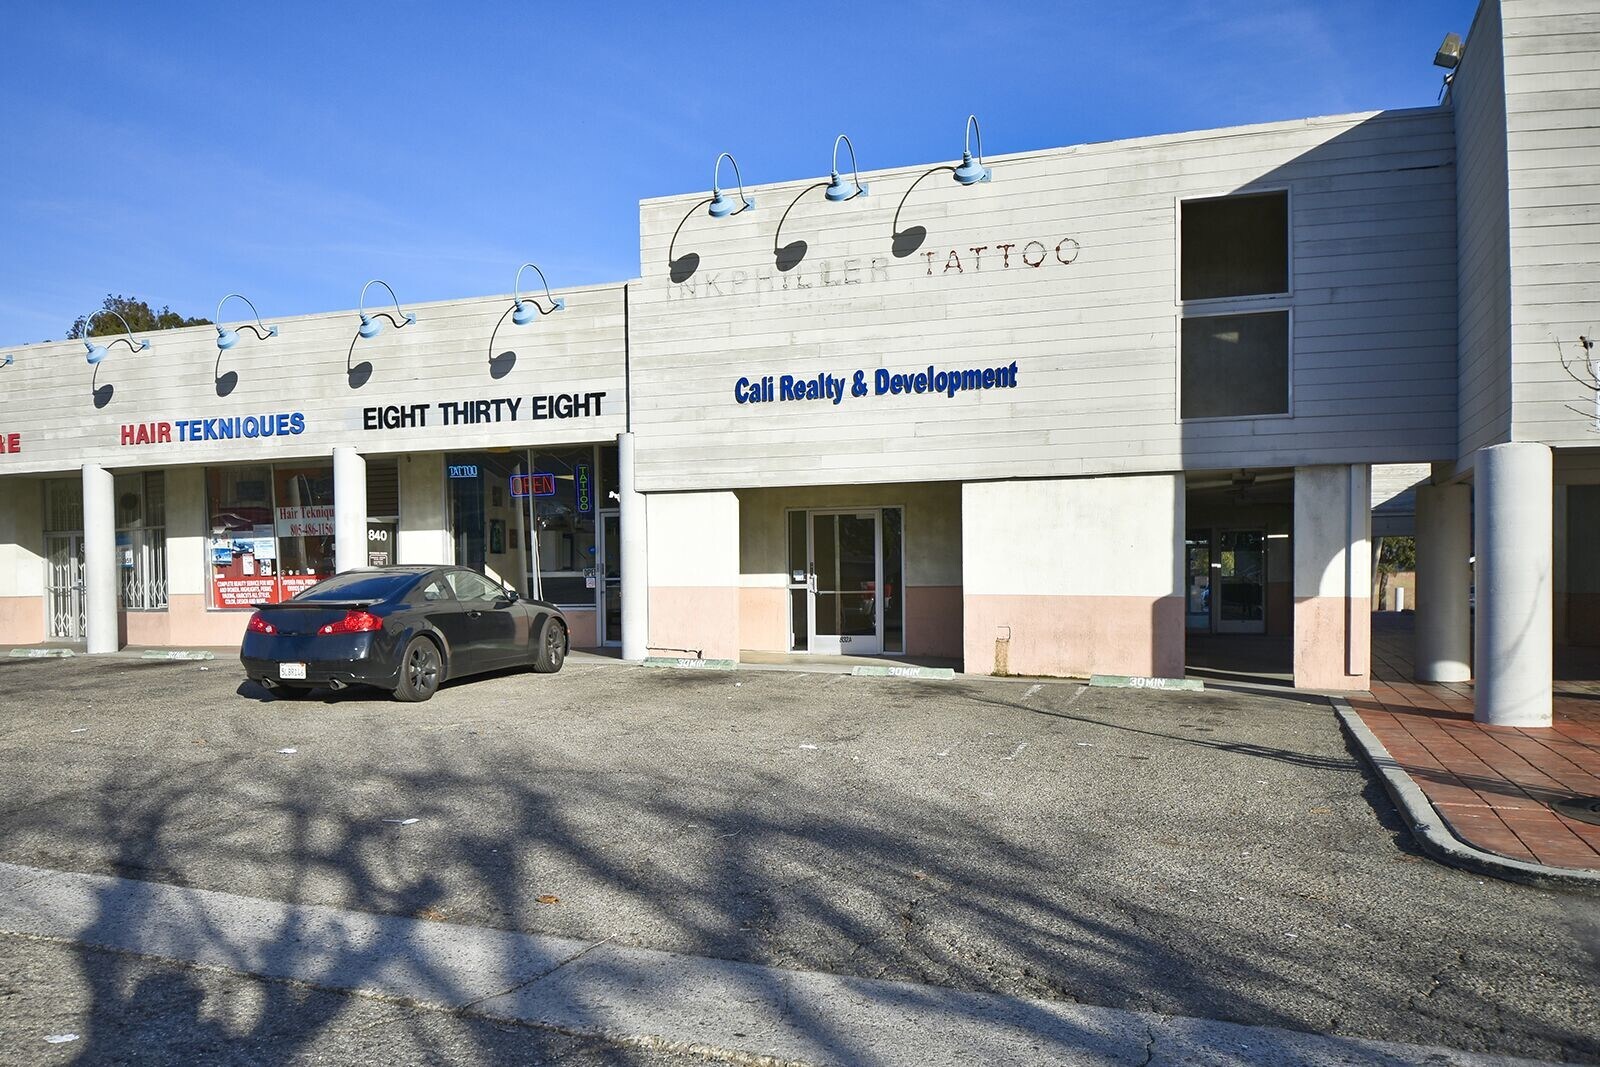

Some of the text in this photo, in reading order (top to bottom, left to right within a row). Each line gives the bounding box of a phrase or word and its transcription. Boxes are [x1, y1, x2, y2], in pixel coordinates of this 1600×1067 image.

[920, 237, 1081, 275] TATTOO
[734, 361, 1018, 406] Cali Realty & Development
[363, 392, 606, 430] EIGHT THIRTY EIGHT
[120, 412, 306, 446] HAIR TEKNIQUES
[448, 465, 478, 478] TATTOO
[512, 475, 553, 495] OPEN
[579, 466, 588, 510] TATTOO
[280, 507, 298, 520] Hair
[368, 529, 388, 541] 840
